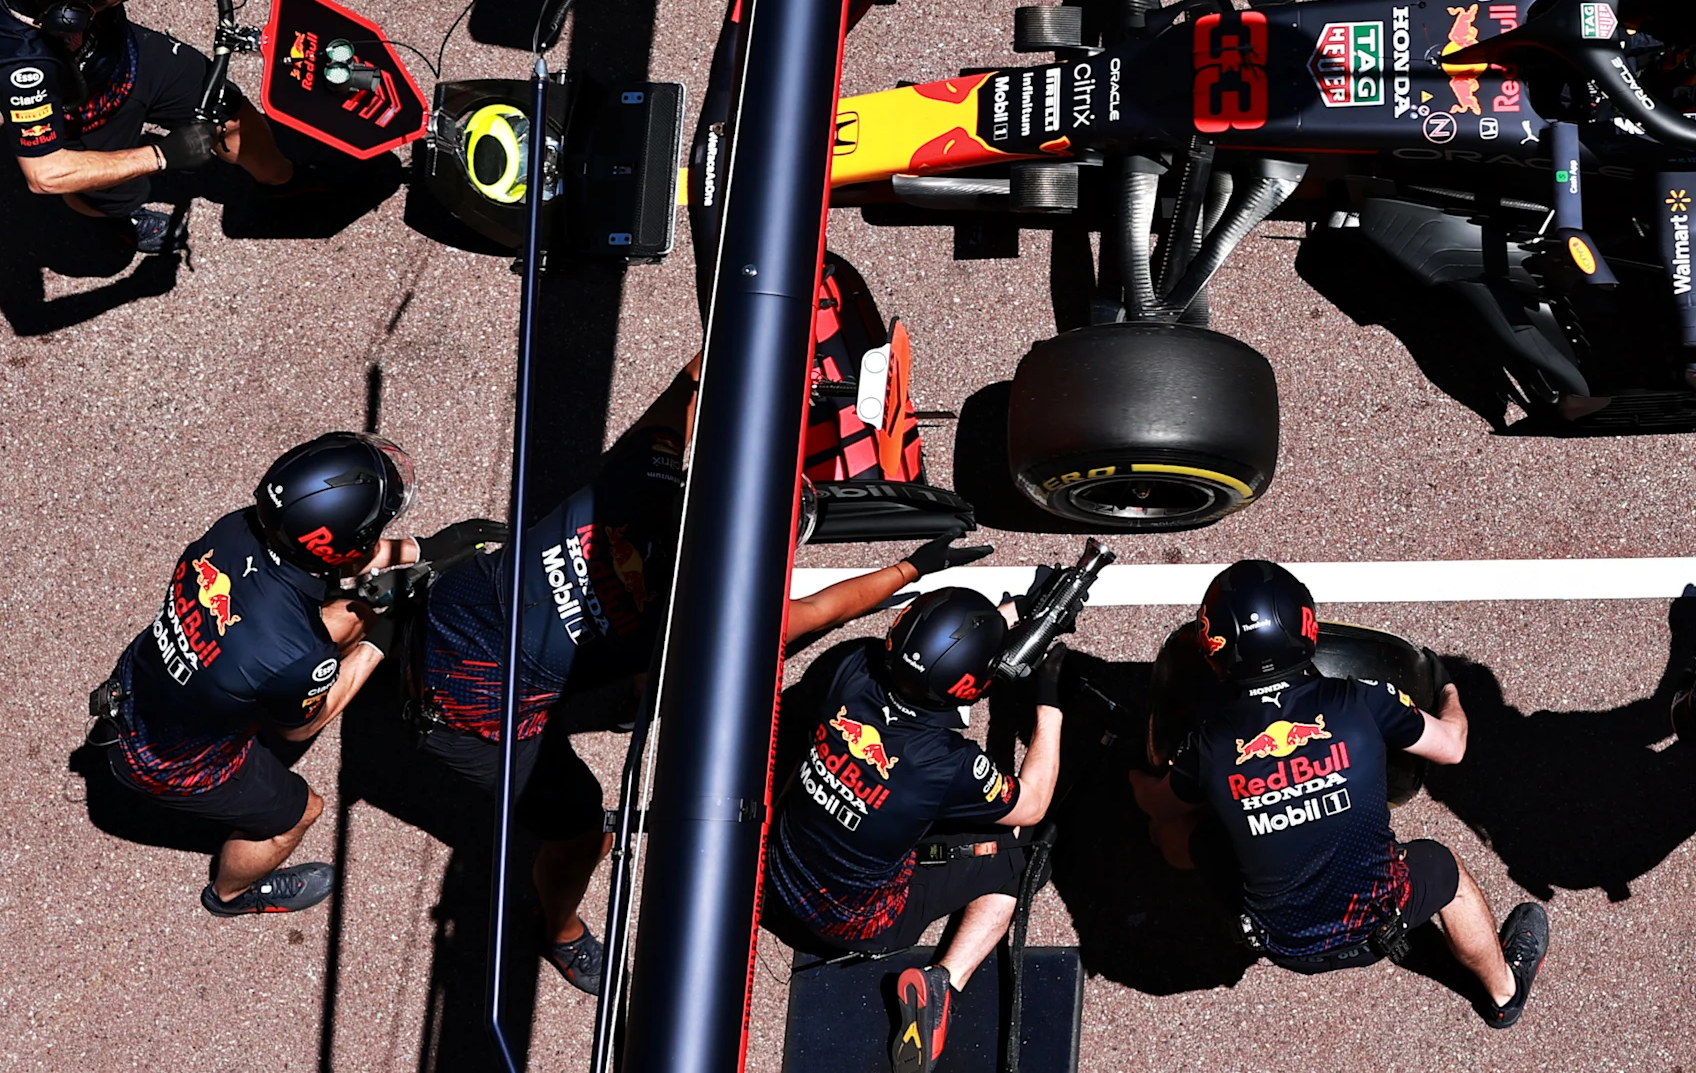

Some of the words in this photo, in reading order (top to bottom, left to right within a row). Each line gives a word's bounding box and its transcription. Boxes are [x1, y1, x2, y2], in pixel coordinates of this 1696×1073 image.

[304, 30, 319, 60] Bull
[1584, 5, 1596, 36] TAG
[1598, 5, 1614, 38] HEUER
[301, 59, 317, 92] Red
[1108, 57, 1122, 122] ORACLE
[1192, 9, 1269, 134] 33
[1318, 27, 1348, 104] HEUER
[1356, 28, 1378, 100] TAG
[1392, 6, 1412, 119] HONDA
[1611, 56, 1656, 111] ORACLE
[9, 89, 48, 107] Claro
[993, 75, 1010, 123] Mobil
[1044, 67, 1061, 133] PIRELLI
[1673, 213, 1692, 296] Walmart
[811, 485, 897, 500] obil
[542, 543, 582, 620] Mobil
[566, 534, 610, 637] HONDA
[183, 610, 223, 669] Bull
[1249, 681, 1290, 697] HONDA
[799, 761, 838, 816] Mobil
[810, 746, 870, 816] HONDA
[815, 723, 848, 775] Red
[841, 759, 892, 811] Bull
[1228, 757, 1288, 801] Red
[1289, 741, 1351, 783] Bull
[1240, 773, 1348, 811] HONDA
[1247, 798, 1321, 837] Mobil
